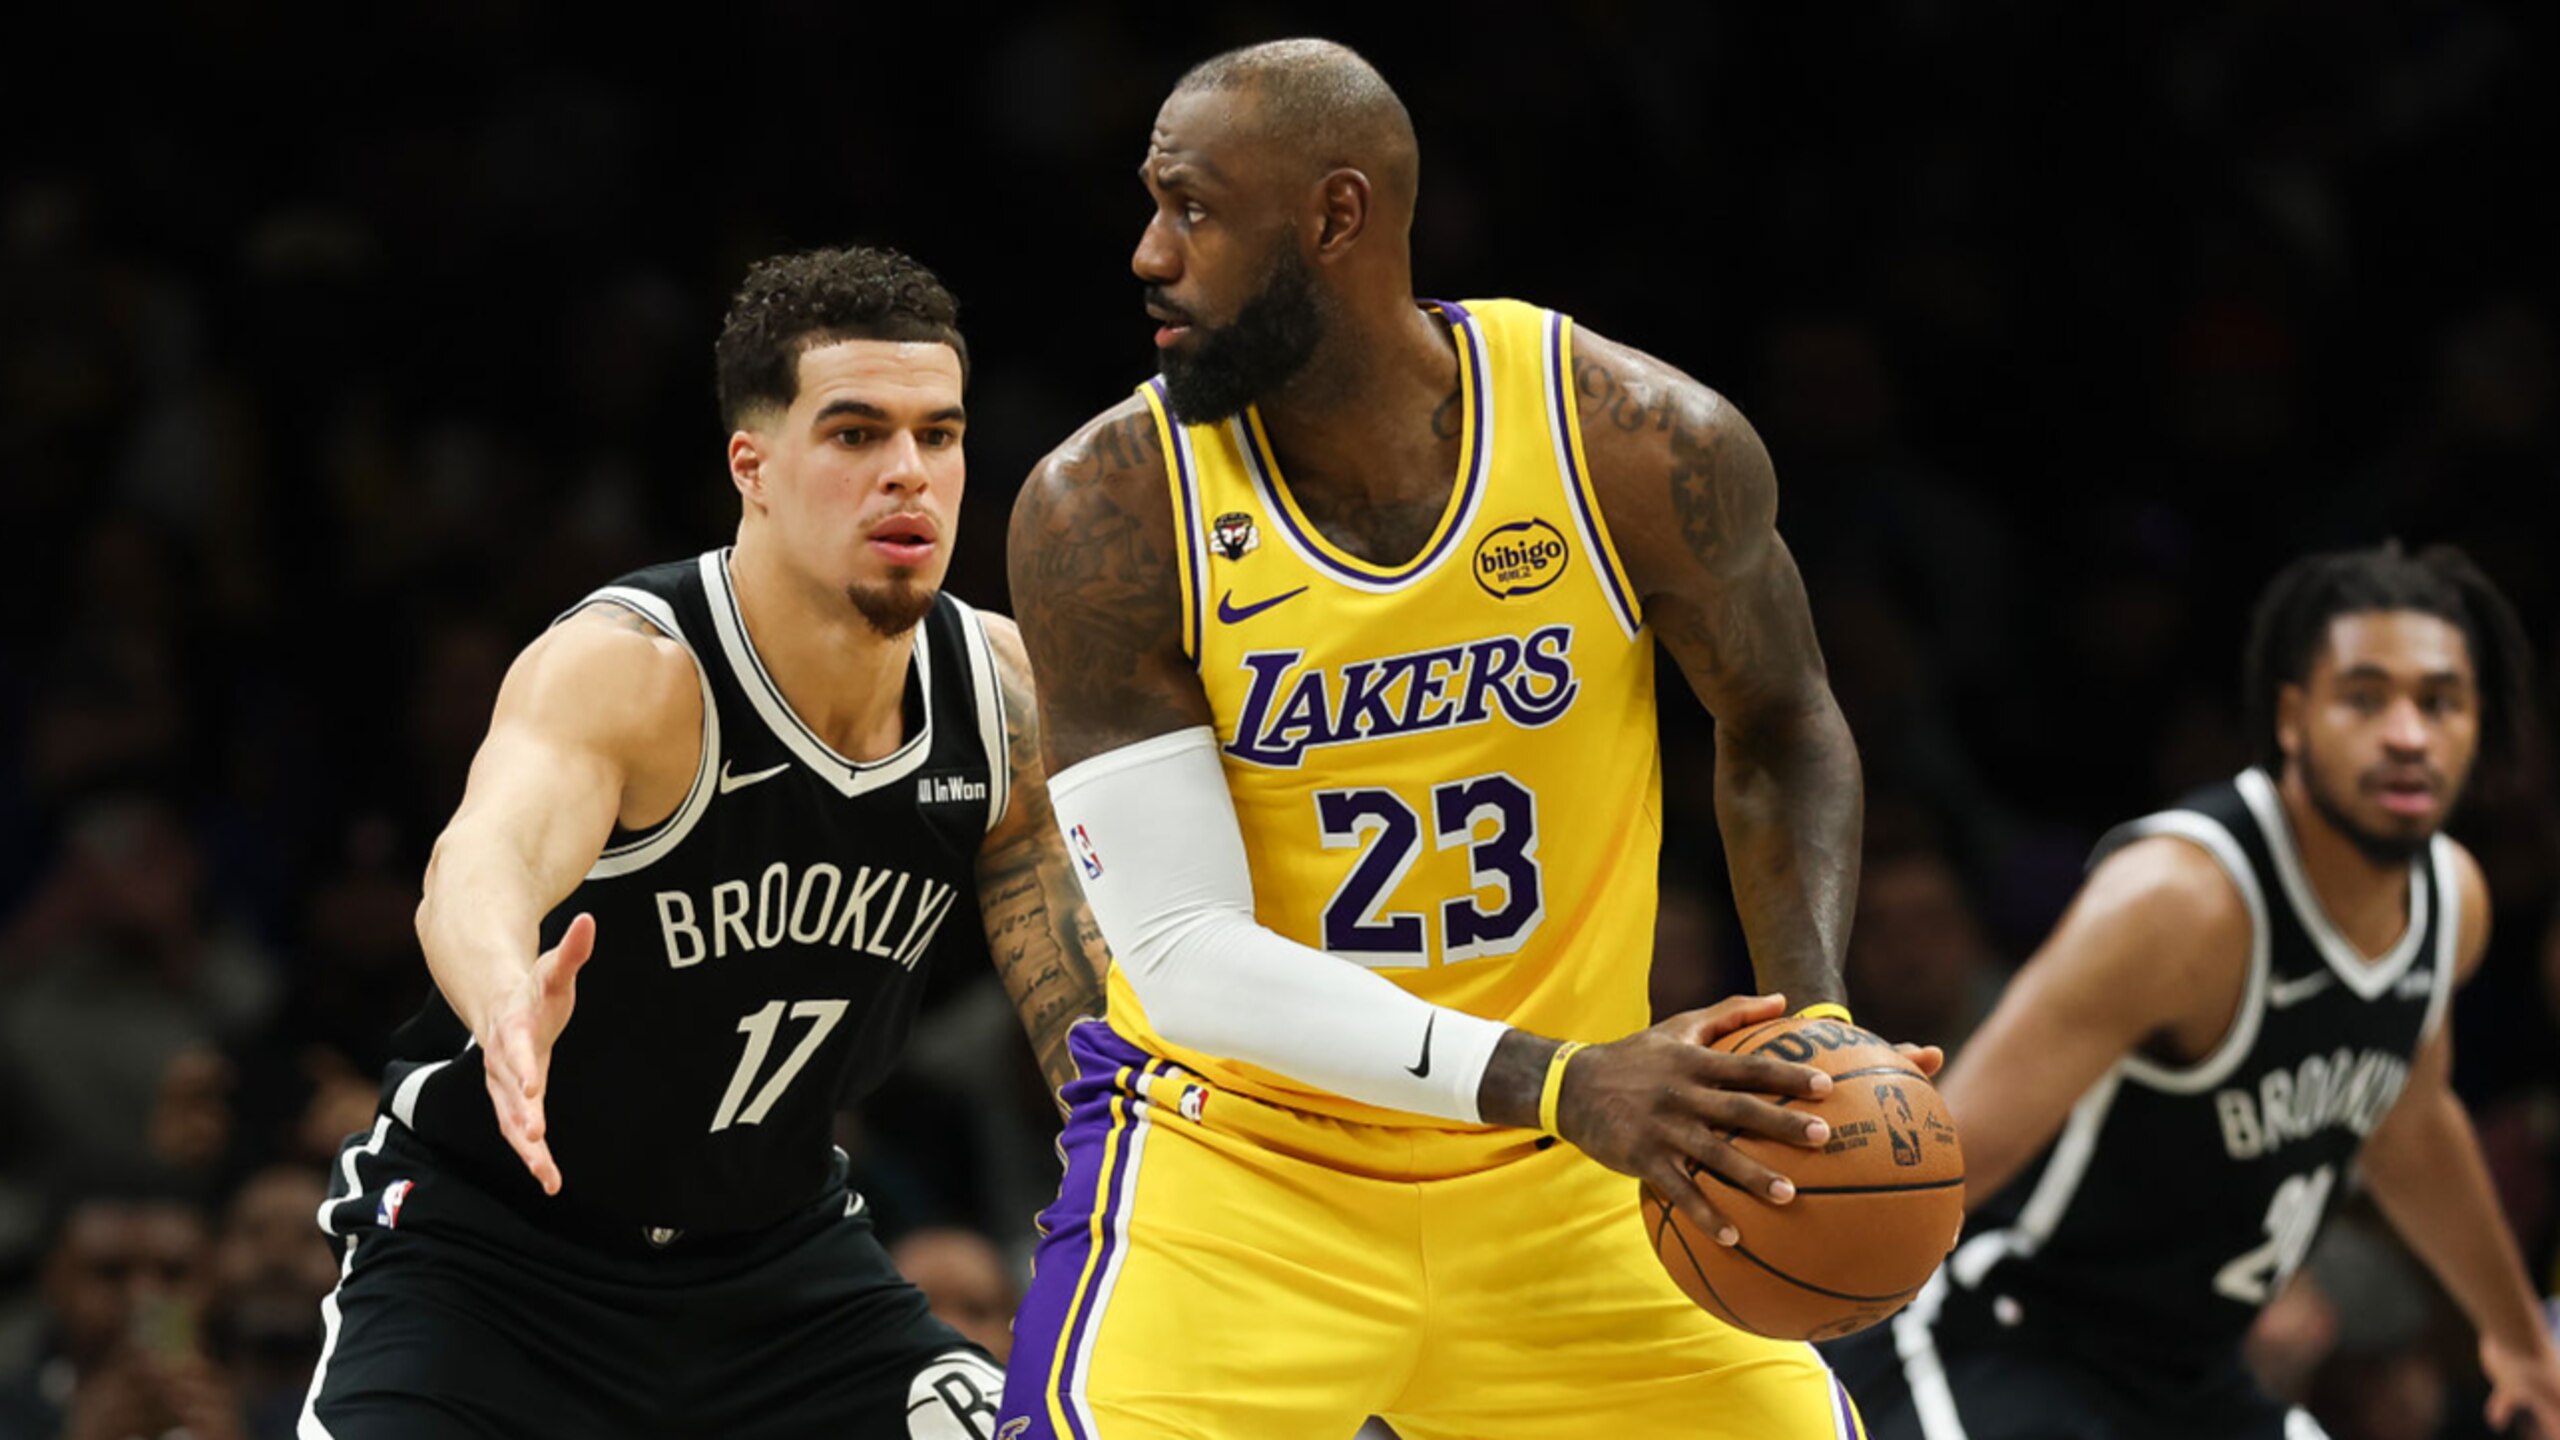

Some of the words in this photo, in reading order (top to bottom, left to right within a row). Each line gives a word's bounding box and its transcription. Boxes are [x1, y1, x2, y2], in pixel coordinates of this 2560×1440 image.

[1481, 540, 1561, 574] bibigo
[1222, 625, 1580, 768] LAKERS
[1312, 772, 1545, 970] 23
[709, 998, 850, 1133] 17
